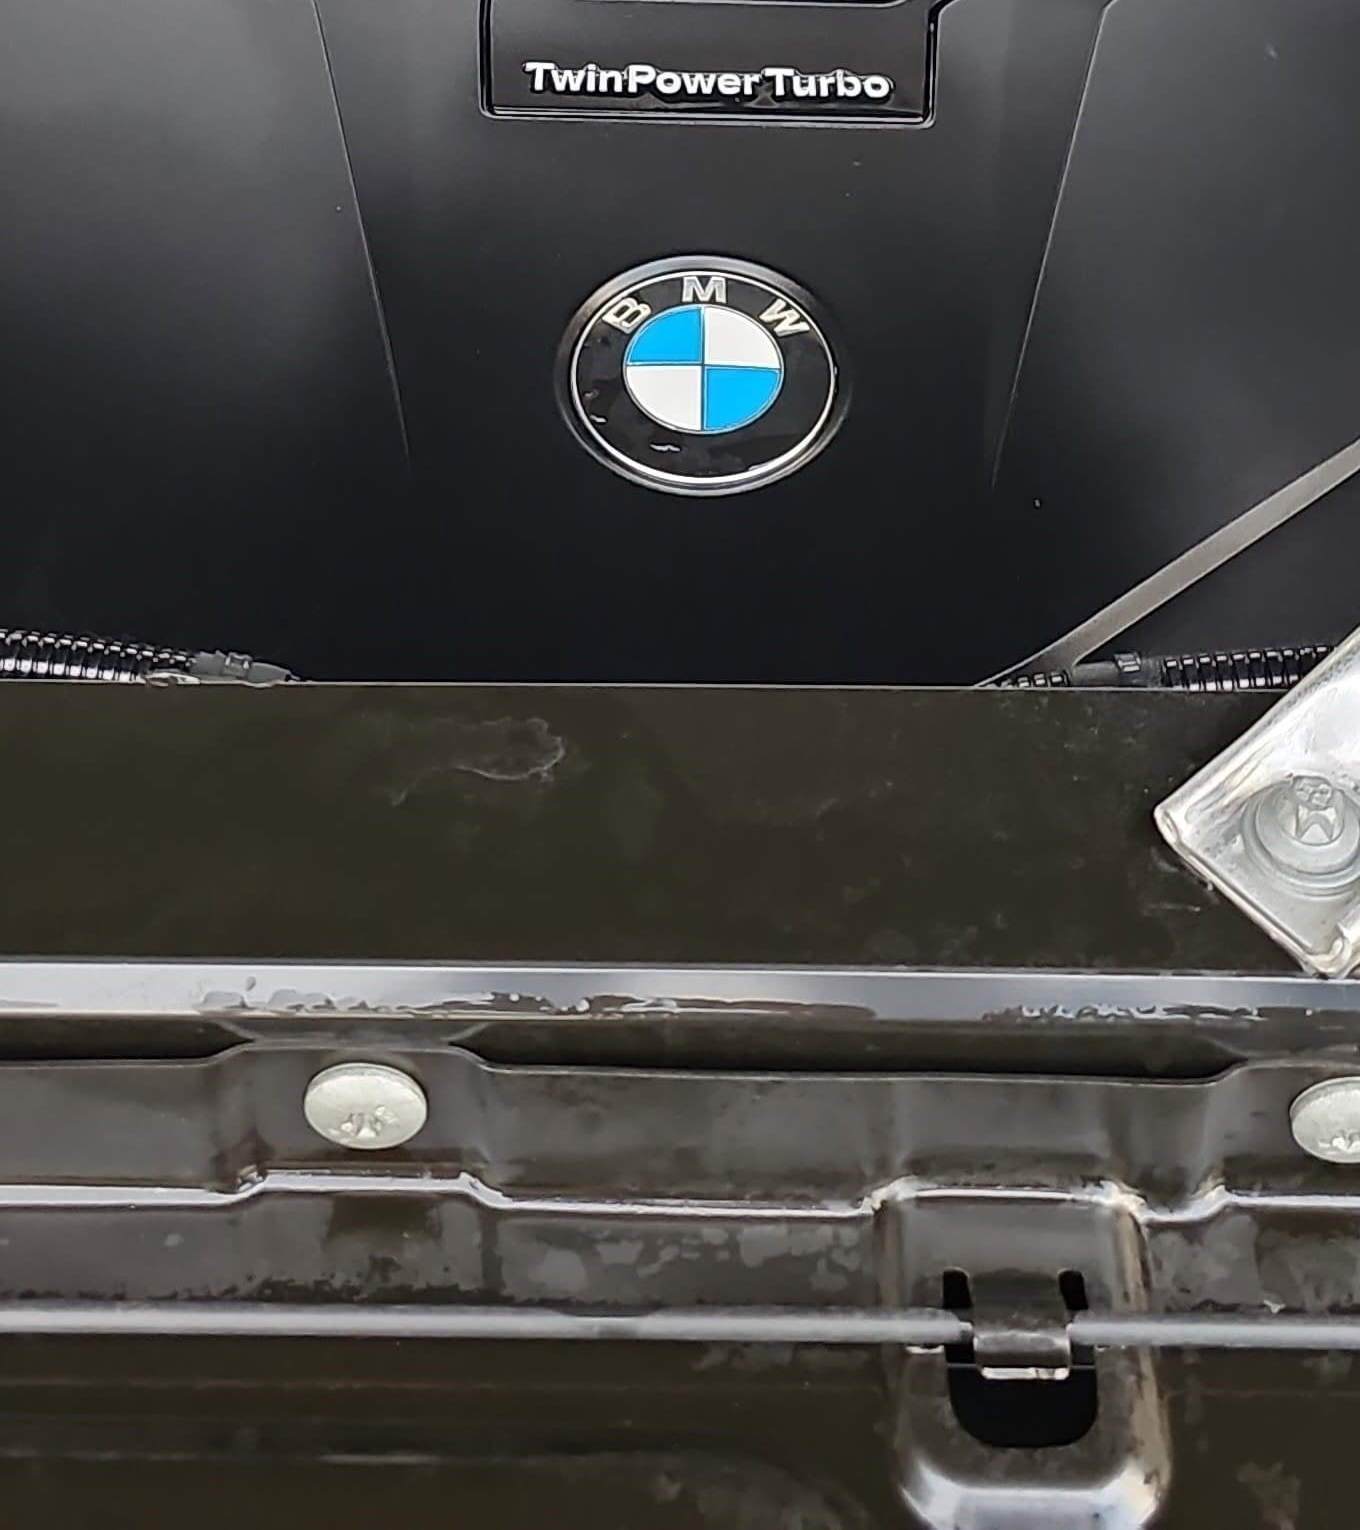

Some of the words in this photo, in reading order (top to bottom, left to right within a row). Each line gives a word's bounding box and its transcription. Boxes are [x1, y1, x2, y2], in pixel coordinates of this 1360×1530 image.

[523, 61, 760, 96] TwinPower
[762, 67, 894, 98] Turbo
[601, 275, 811, 338] BMW
